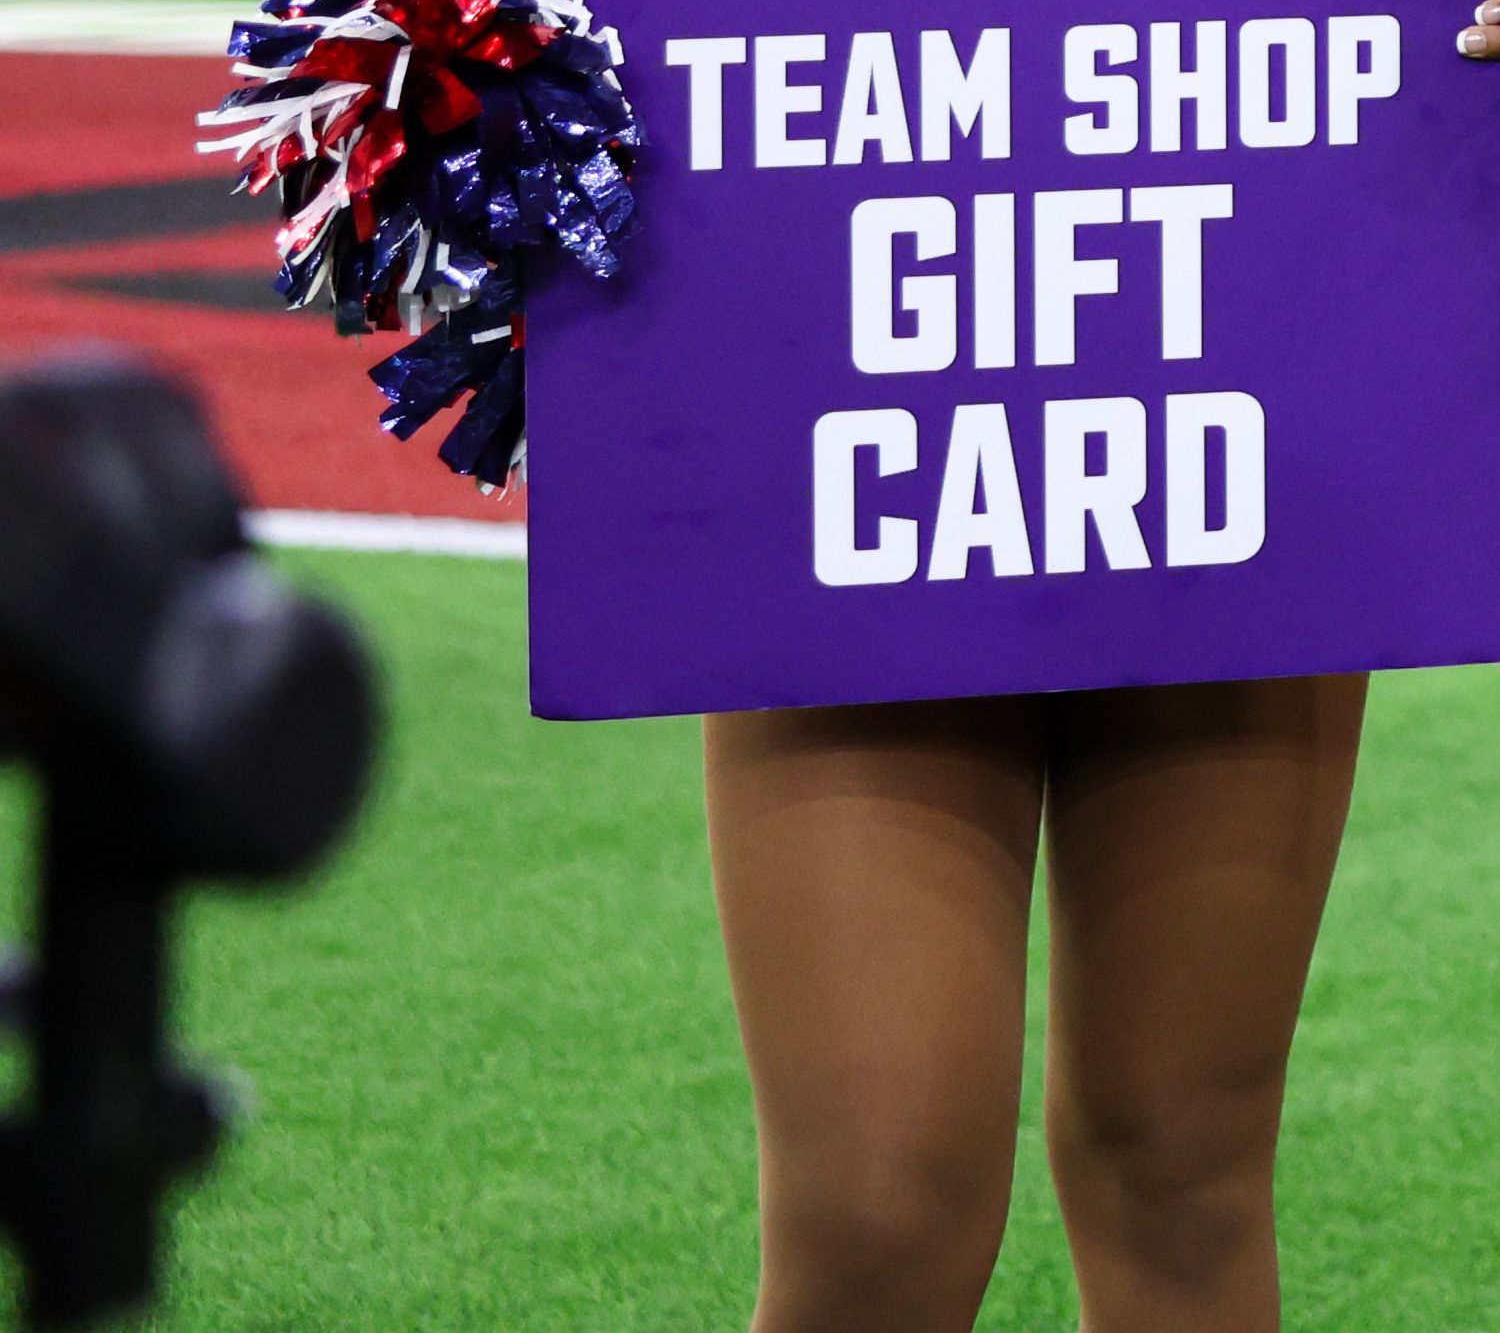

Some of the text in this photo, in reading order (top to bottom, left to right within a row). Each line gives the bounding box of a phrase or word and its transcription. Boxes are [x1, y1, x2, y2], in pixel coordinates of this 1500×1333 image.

[665, 14, 1401, 171] TEAM SHOP
[850, 183, 1235, 375] GIFT
[813, 390, 1267, 587] CARD
